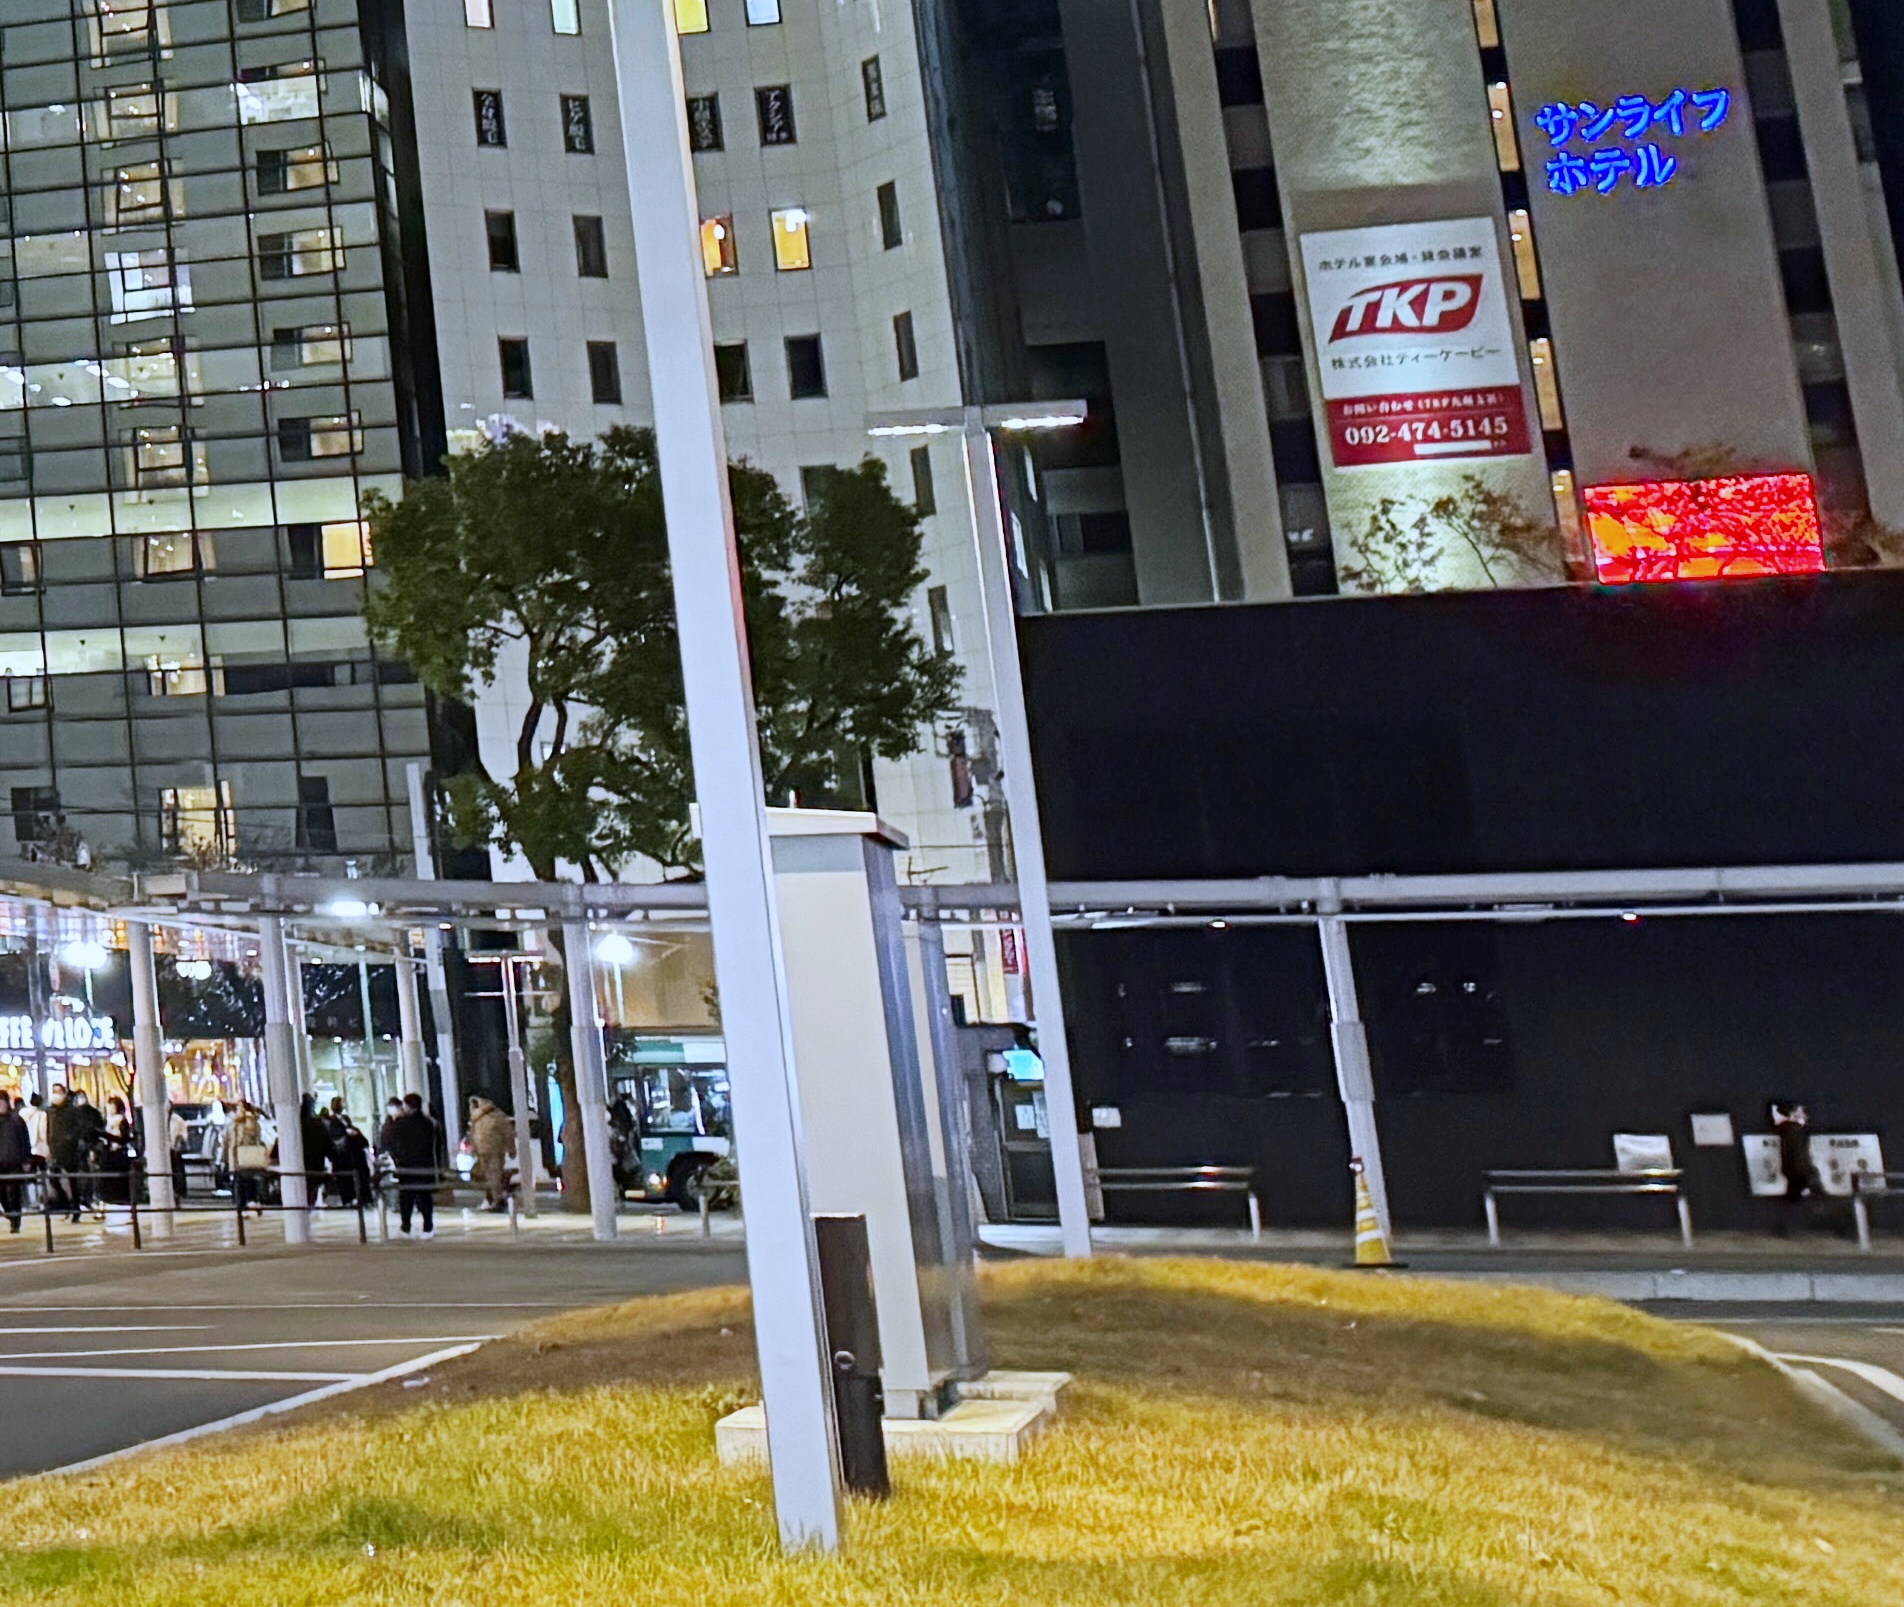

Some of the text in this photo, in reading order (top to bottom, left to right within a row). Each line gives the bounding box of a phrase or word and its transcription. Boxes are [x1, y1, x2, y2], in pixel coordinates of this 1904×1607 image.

[1536, 88, 1730, 145] サンライフ
[1545, 145, 1676, 195] ホテル
[1344, 280, 1473, 332] TKP
[1344, 416, 1508, 446] 092-474-5145
